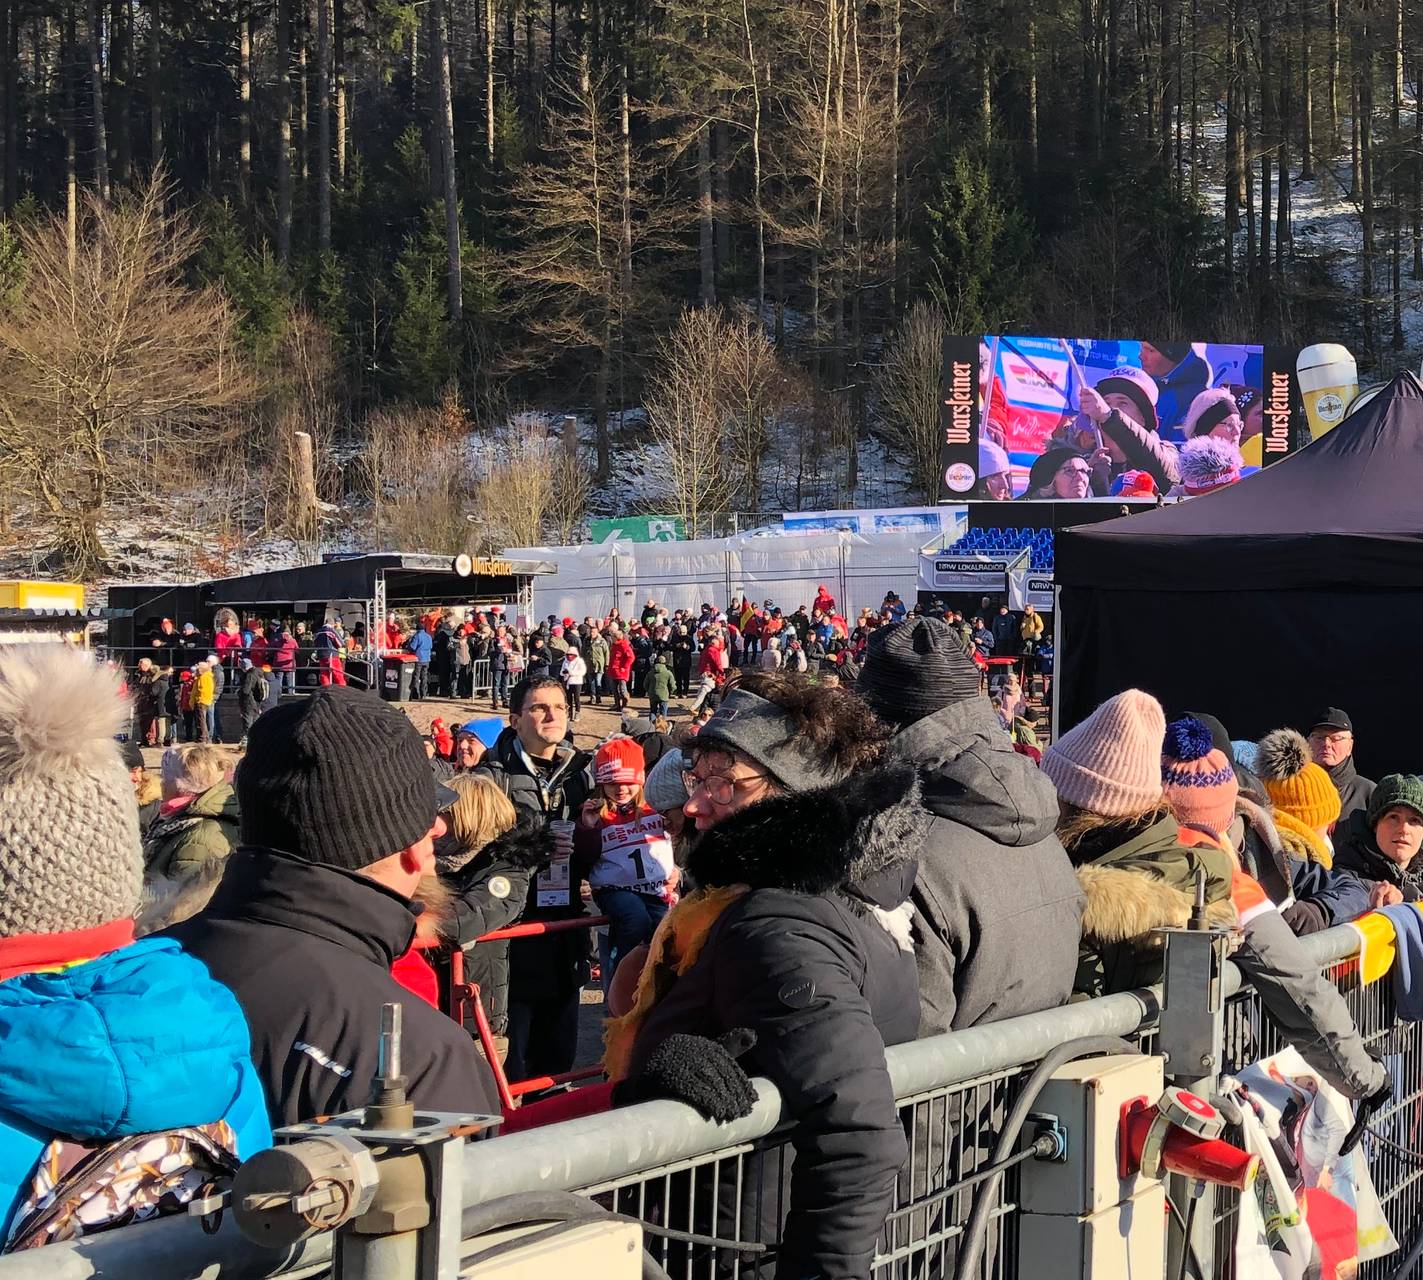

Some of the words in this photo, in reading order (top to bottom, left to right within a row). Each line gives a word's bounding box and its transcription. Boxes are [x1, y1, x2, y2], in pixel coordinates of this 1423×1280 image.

[945, 361, 975, 445] Warsteiner
[1264, 371, 1292, 454] Warsteiner
[472, 556, 513, 577] Warsteiner
[938, 562, 957, 571] NRW
[958, 563, 1004, 571] LOKALRADIOS
[1031, 582, 1050, 590] NRW
[627, 848, 646, 880] 1
